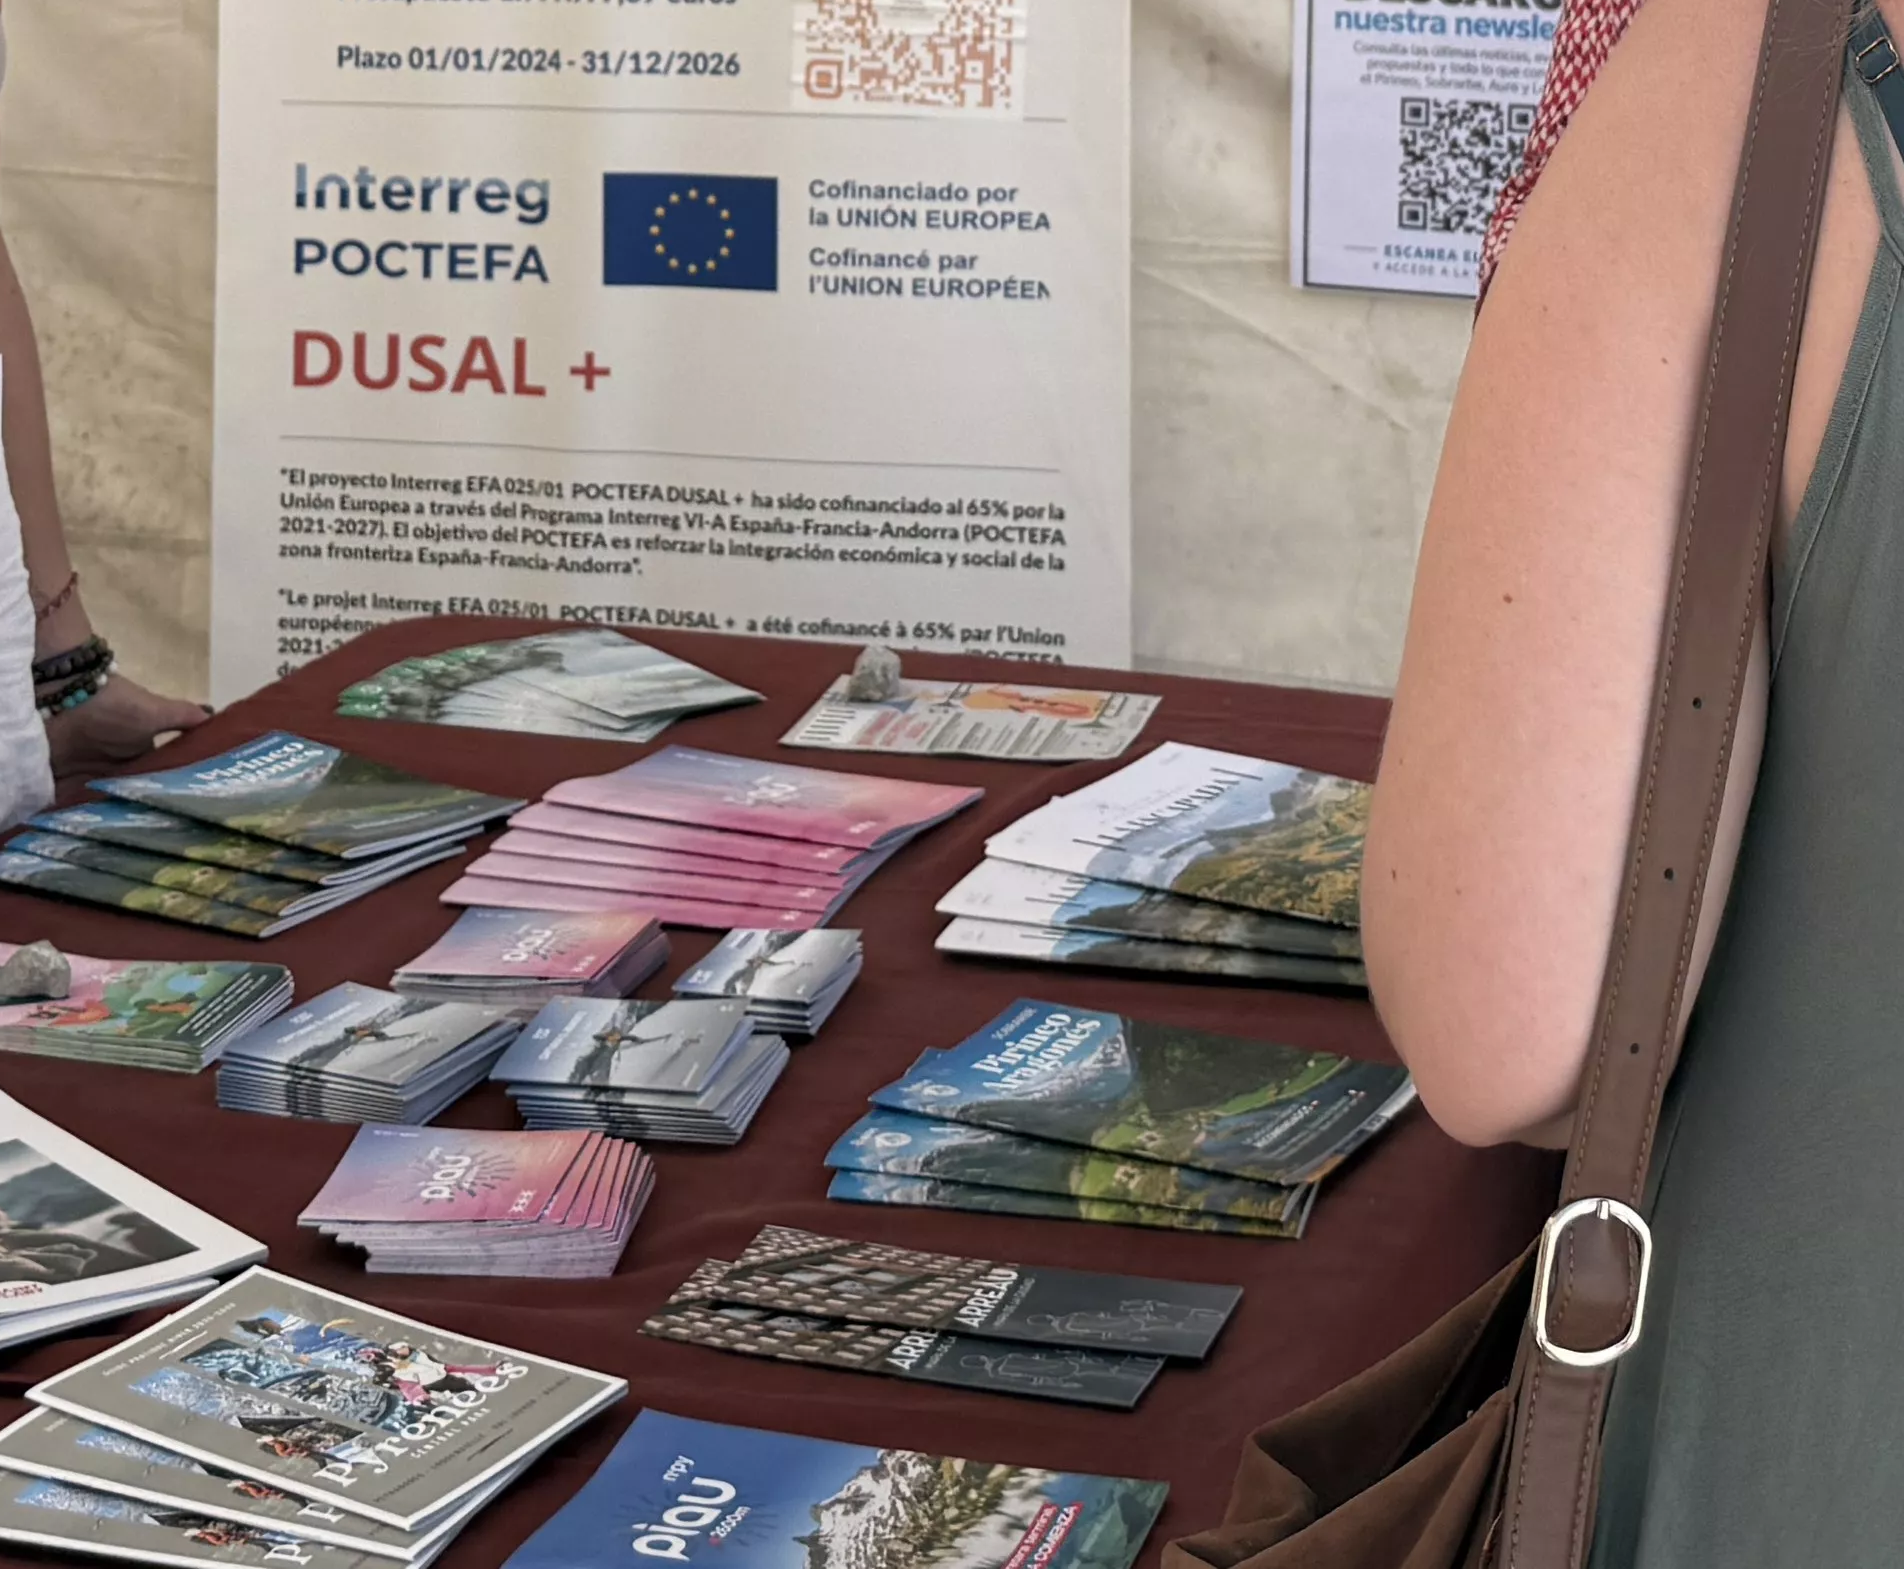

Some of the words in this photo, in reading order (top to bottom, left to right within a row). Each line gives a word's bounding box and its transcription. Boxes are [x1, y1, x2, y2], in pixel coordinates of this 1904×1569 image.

[1334, 9, 1446, 35] nuestra
[1455, 13, 1555, 41] newsle
[337, 45, 402, 70] Plazo
[408, 46, 562, 73] 01/01/2024
[581, 50, 741, 77] 31/12/2026
[294, 162, 552, 224] Interreg
[808, 178, 969, 203] Cofinanciado
[976, 185, 1019, 207] por
[808, 207, 830, 227] la
[837, 205, 917, 229] UNIÓN
[925, 210, 1052, 231] EUROPEA
[294, 239, 550, 284] POCTEFA
[808, 247, 931, 269] Cofinancé
[938, 253, 979, 274] par
[291, 329, 547, 398] DUSAL
[569, 350, 611, 393] +
[280, 492, 335, 511] Unión
[339, 494, 411, 516] Europea
[429, 498, 486, 517] través
[490, 500, 518, 519] del
[520, 503, 604, 527] Programa
[608, 507, 681, 532] Interreg
[683, 511, 727, 532] VI-A
[729, 514, 959, 541] España-Francia-Andorra
[963, 523, 1067, 547] (POCTEFA
[308, 472, 388, 492] proyecto
[390, 473, 462, 495] Interreg
[466, 476, 503, 494] EFA
[504, 477, 564, 499] 025/01
[571, 482, 665, 502] POCTEFA
[666, 485, 729, 506] DUSAL
[750, 490, 774, 509] ha
[777, 492, 816, 510] sido
[819, 494, 943, 515] cofinanciado
[946, 497, 964, 516] al
[967, 499, 1009, 517] 65%
[1012, 505, 1045, 522] por
[1048, 503, 1066, 521] la
[278, 543, 322, 559] zona
[326, 541, 414, 564] fronteriza
[393, 521, 409, 539] El
[412, 522, 489, 543] objetivo
[491, 525, 518, 543] del
[520, 528, 607, 550] POCTEFA
[610, 536, 631, 551] es
[635, 534, 705, 554] reforzar
[708, 537, 725, 556] la
[728, 538, 835, 562] integración
[838, 545, 942, 566] económica
[946, 552, 958, 569] y
[961, 549, 1016, 569] social
[1020, 552, 1044, 571] de
[1048, 553, 1066, 572] la
[313, 590, 367, 611] projet
[371, 592, 443, 616] Interreg
[447, 596, 484, 614] EFA
[559, 603, 653, 624] POCTEFA
[655, 608, 721, 630] DUSAL
[762, 616, 793, 634] été
[797, 618, 891, 638] cofinancé
[912, 621, 955, 640] 65%
[960, 627, 993, 644] par
[970, 1013, 1072, 1075] Pirineo
[954, 1268, 1019, 1328] ARREAU
